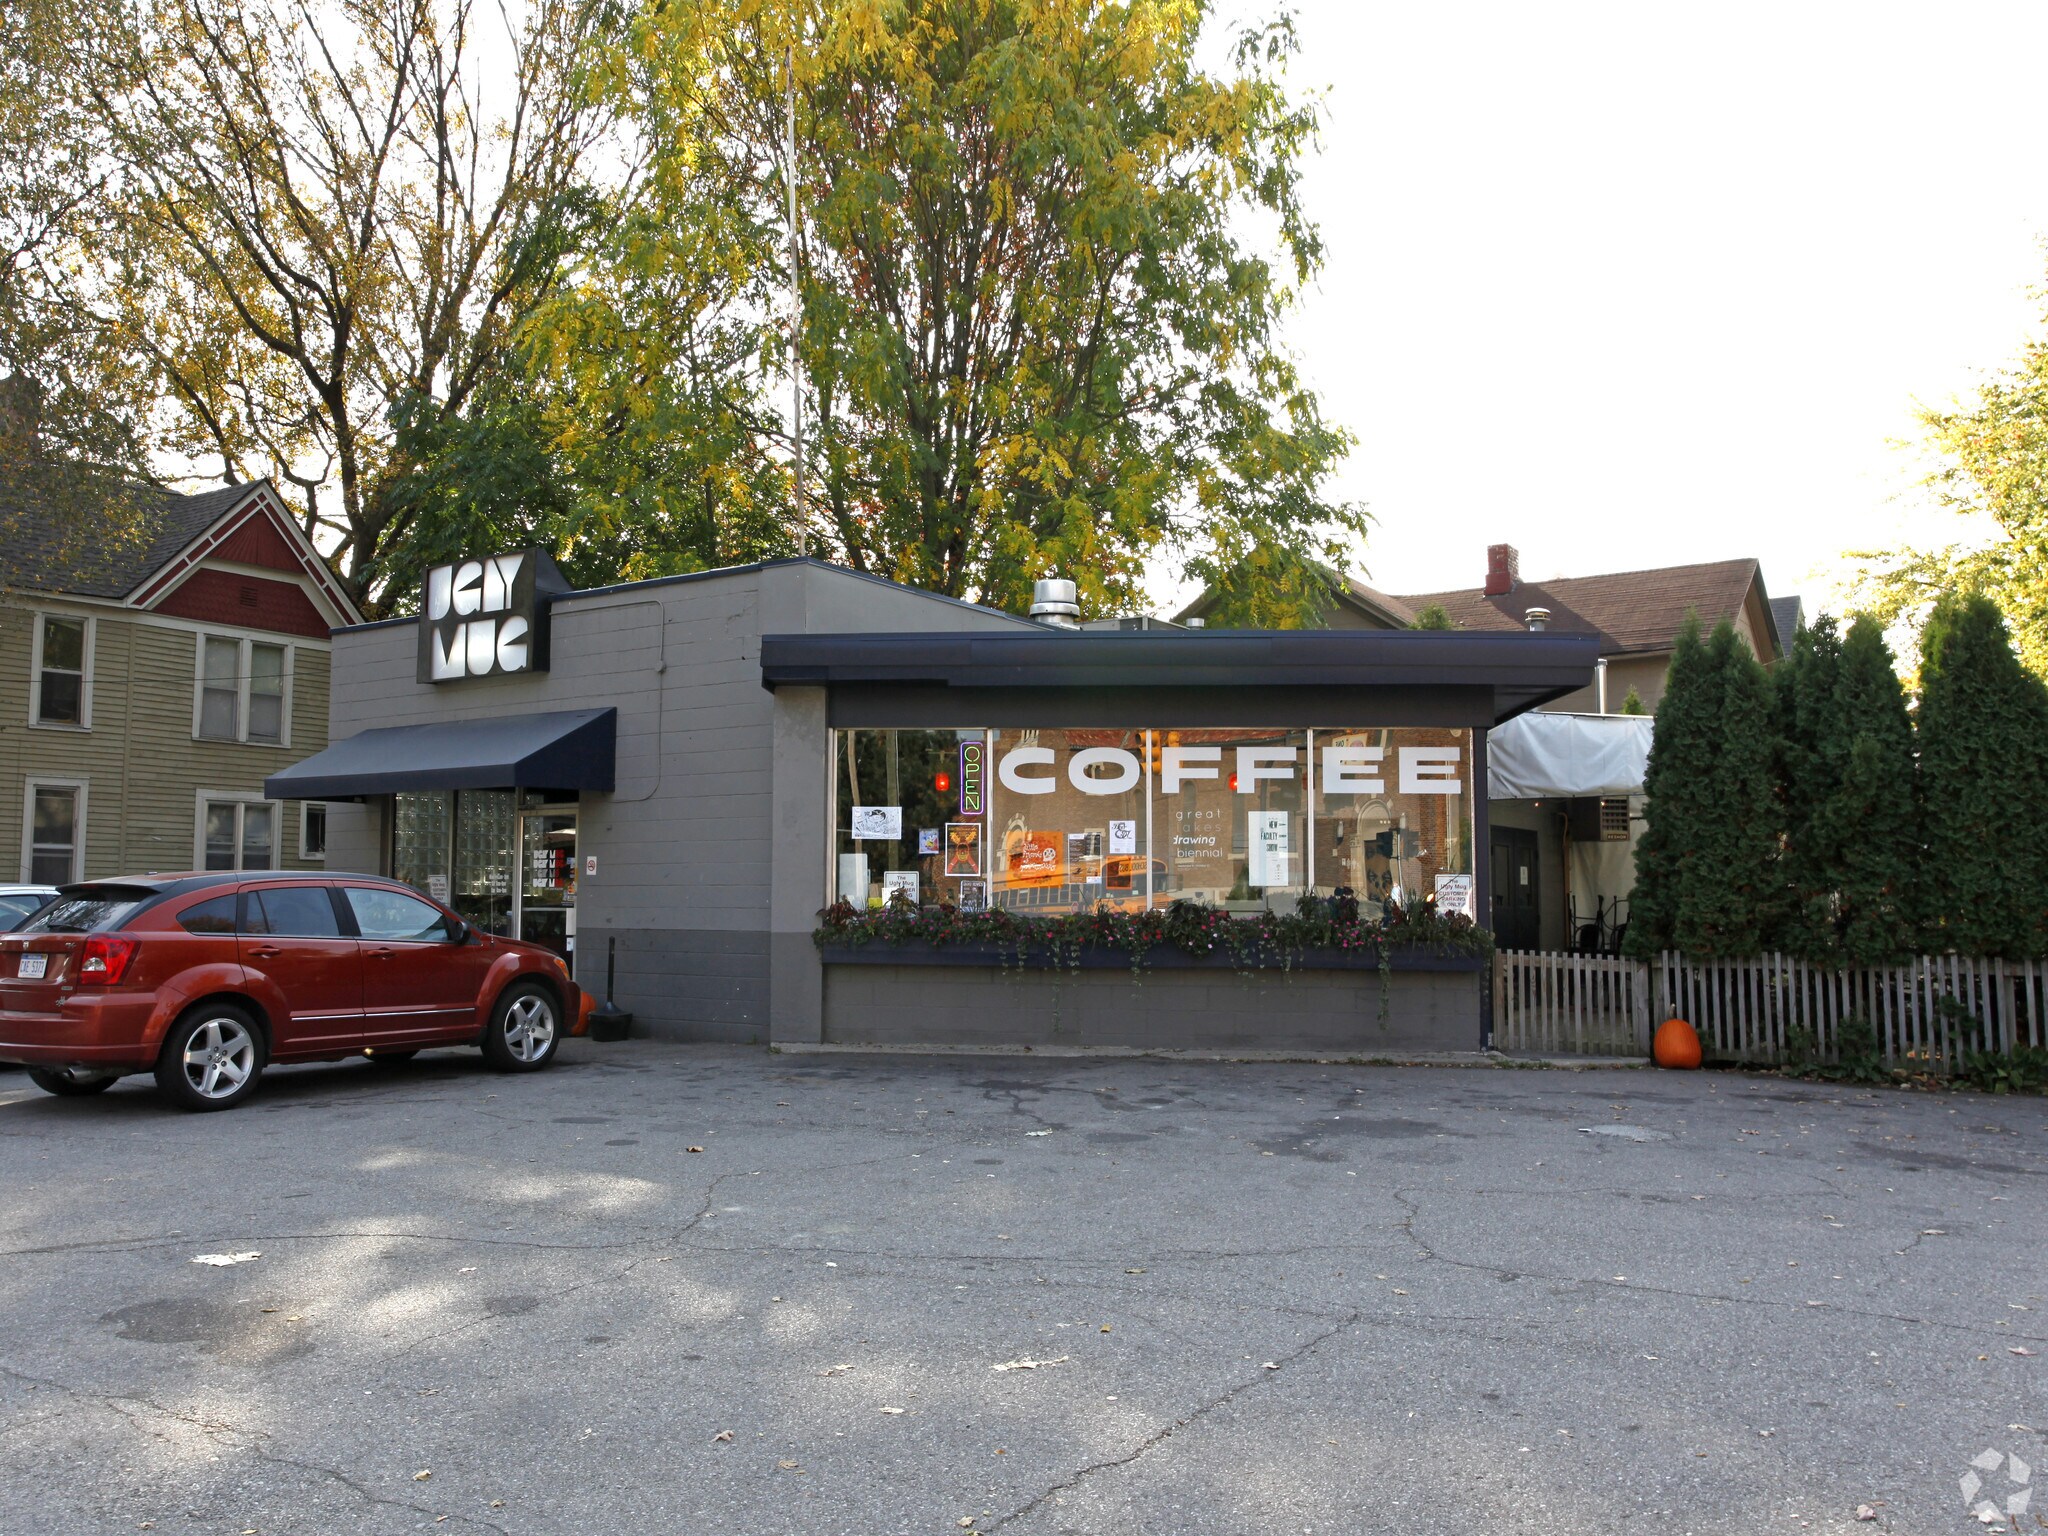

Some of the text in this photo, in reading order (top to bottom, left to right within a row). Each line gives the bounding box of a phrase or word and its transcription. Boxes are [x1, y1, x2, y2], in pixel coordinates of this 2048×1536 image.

[427, 553, 525, 621] UGLY
[431, 615, 528, 680] MUG
[998, 746, 1461, 795] COFFEE
[964, 746, 980, 811] OPEN
[1175, 808, 1222, 821] great
[1177, 822, 1222, 832] lakes
[1268, 820, 1278, 829] NEW
[1173, 835, 1216, 846] drawing
[1260, 832, 1278, 841] FACULTY
[1177, 848, 1223, 858] biennial
[1266, 844, 1278, 852] SHOW
